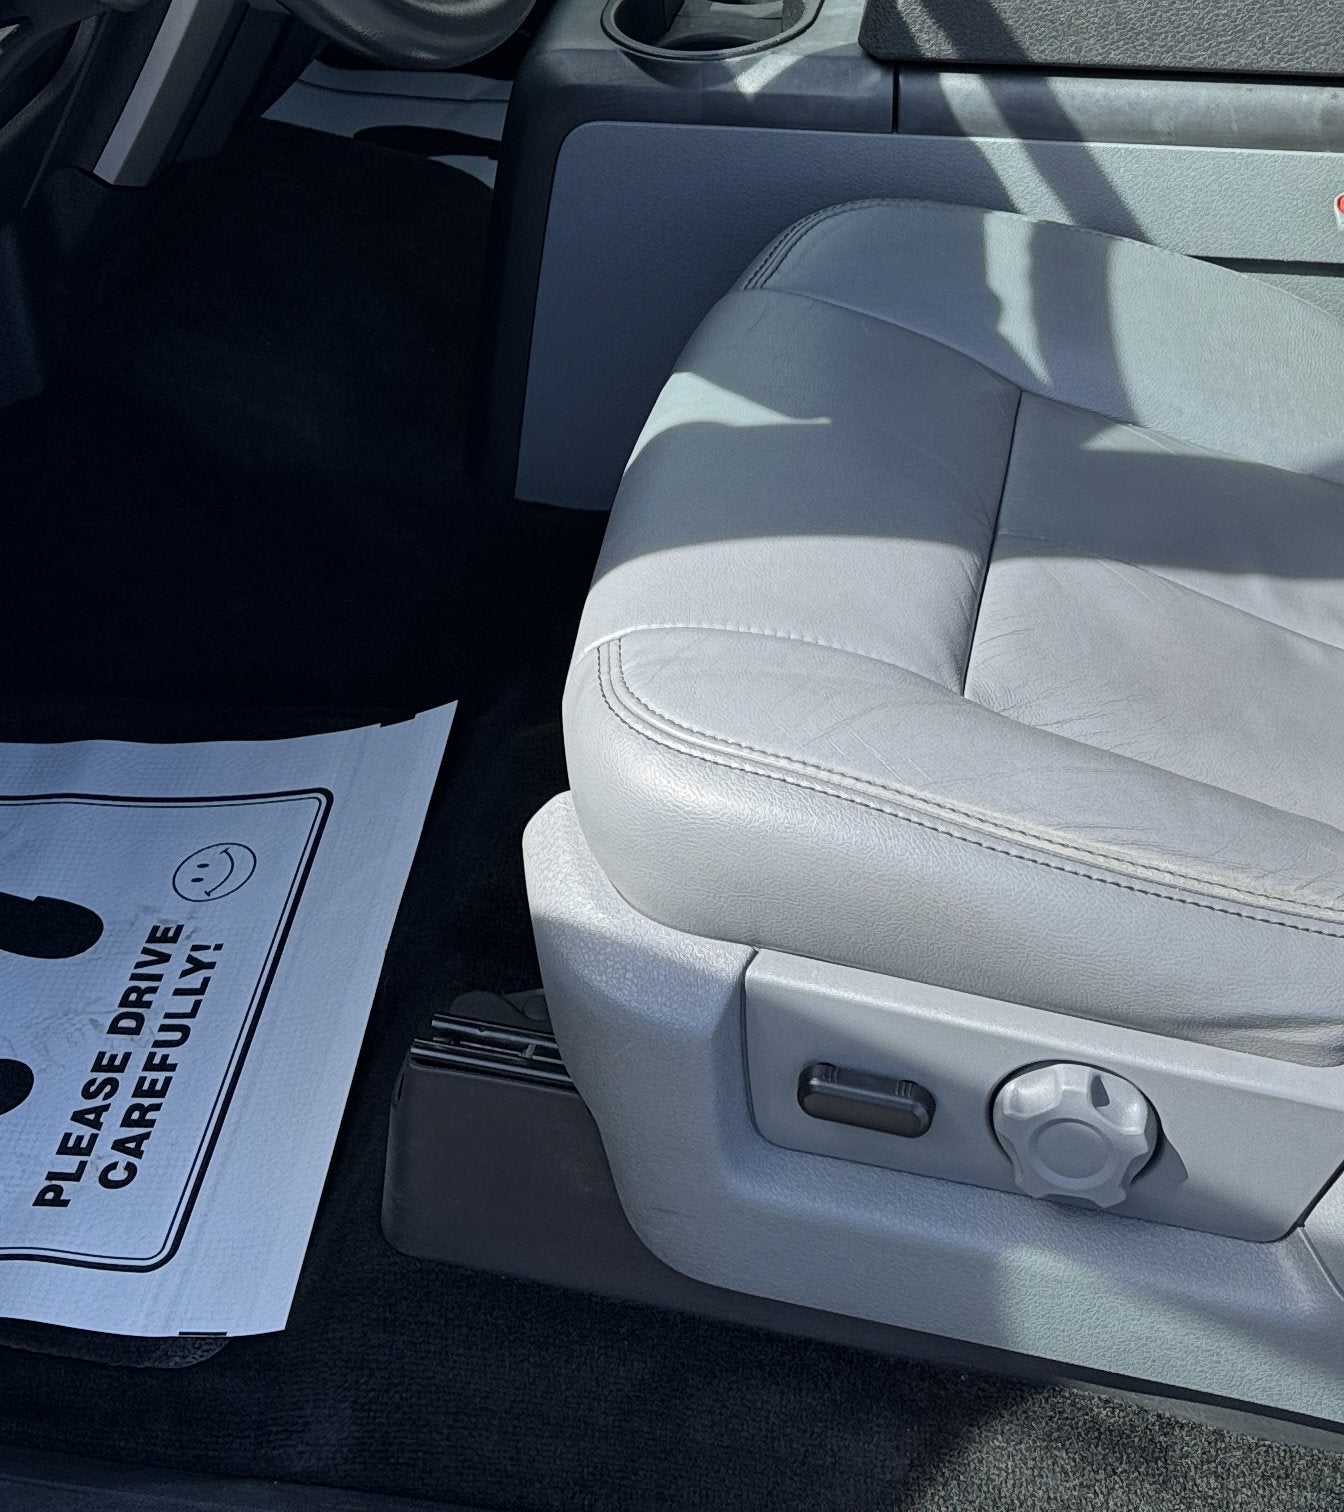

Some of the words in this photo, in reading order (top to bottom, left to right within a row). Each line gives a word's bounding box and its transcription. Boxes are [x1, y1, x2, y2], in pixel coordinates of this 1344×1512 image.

[32, 1051, 132, 1208] PLEASE
[106, 923, 185, 1036] DRIVE
[97, 942, 224, 1190] CAREFULLY!
